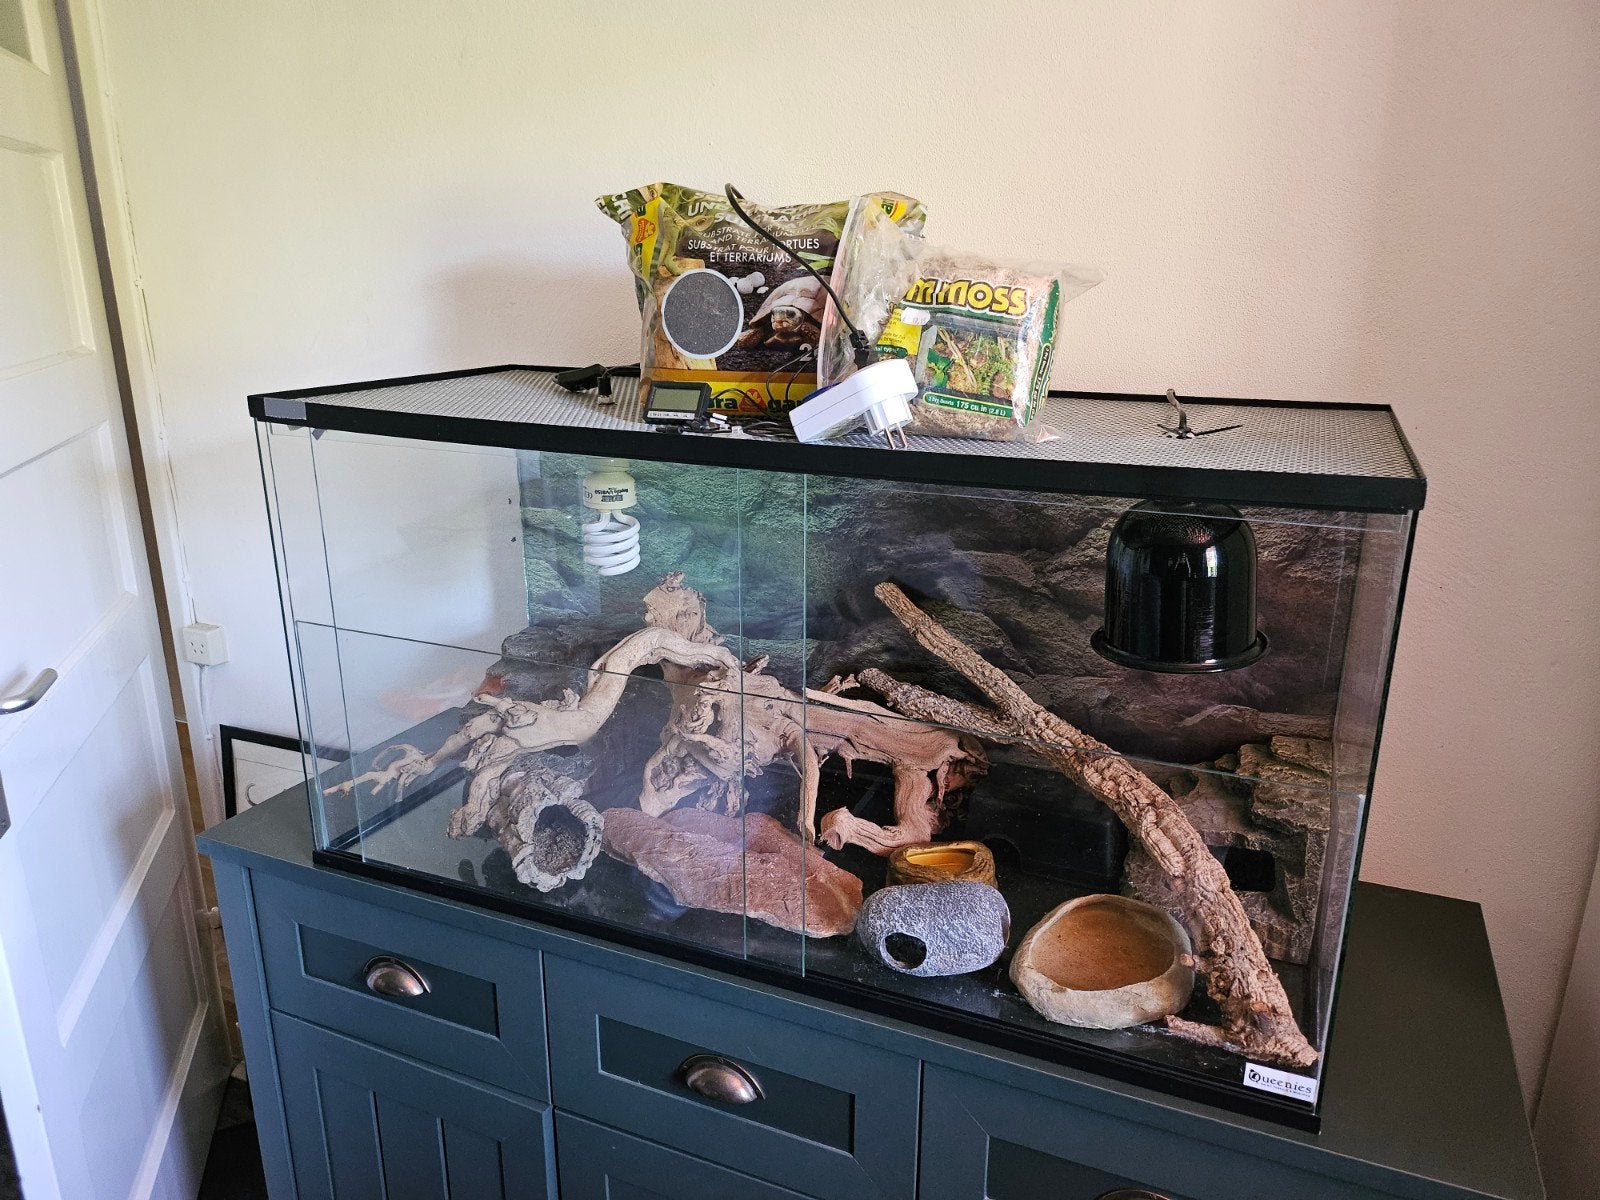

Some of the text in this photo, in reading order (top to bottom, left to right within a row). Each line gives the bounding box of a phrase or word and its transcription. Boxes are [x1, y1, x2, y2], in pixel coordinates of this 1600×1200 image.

[709, 251, 792, 263] ET TERRARIUMS
[956, 400, 970, 409] 175
